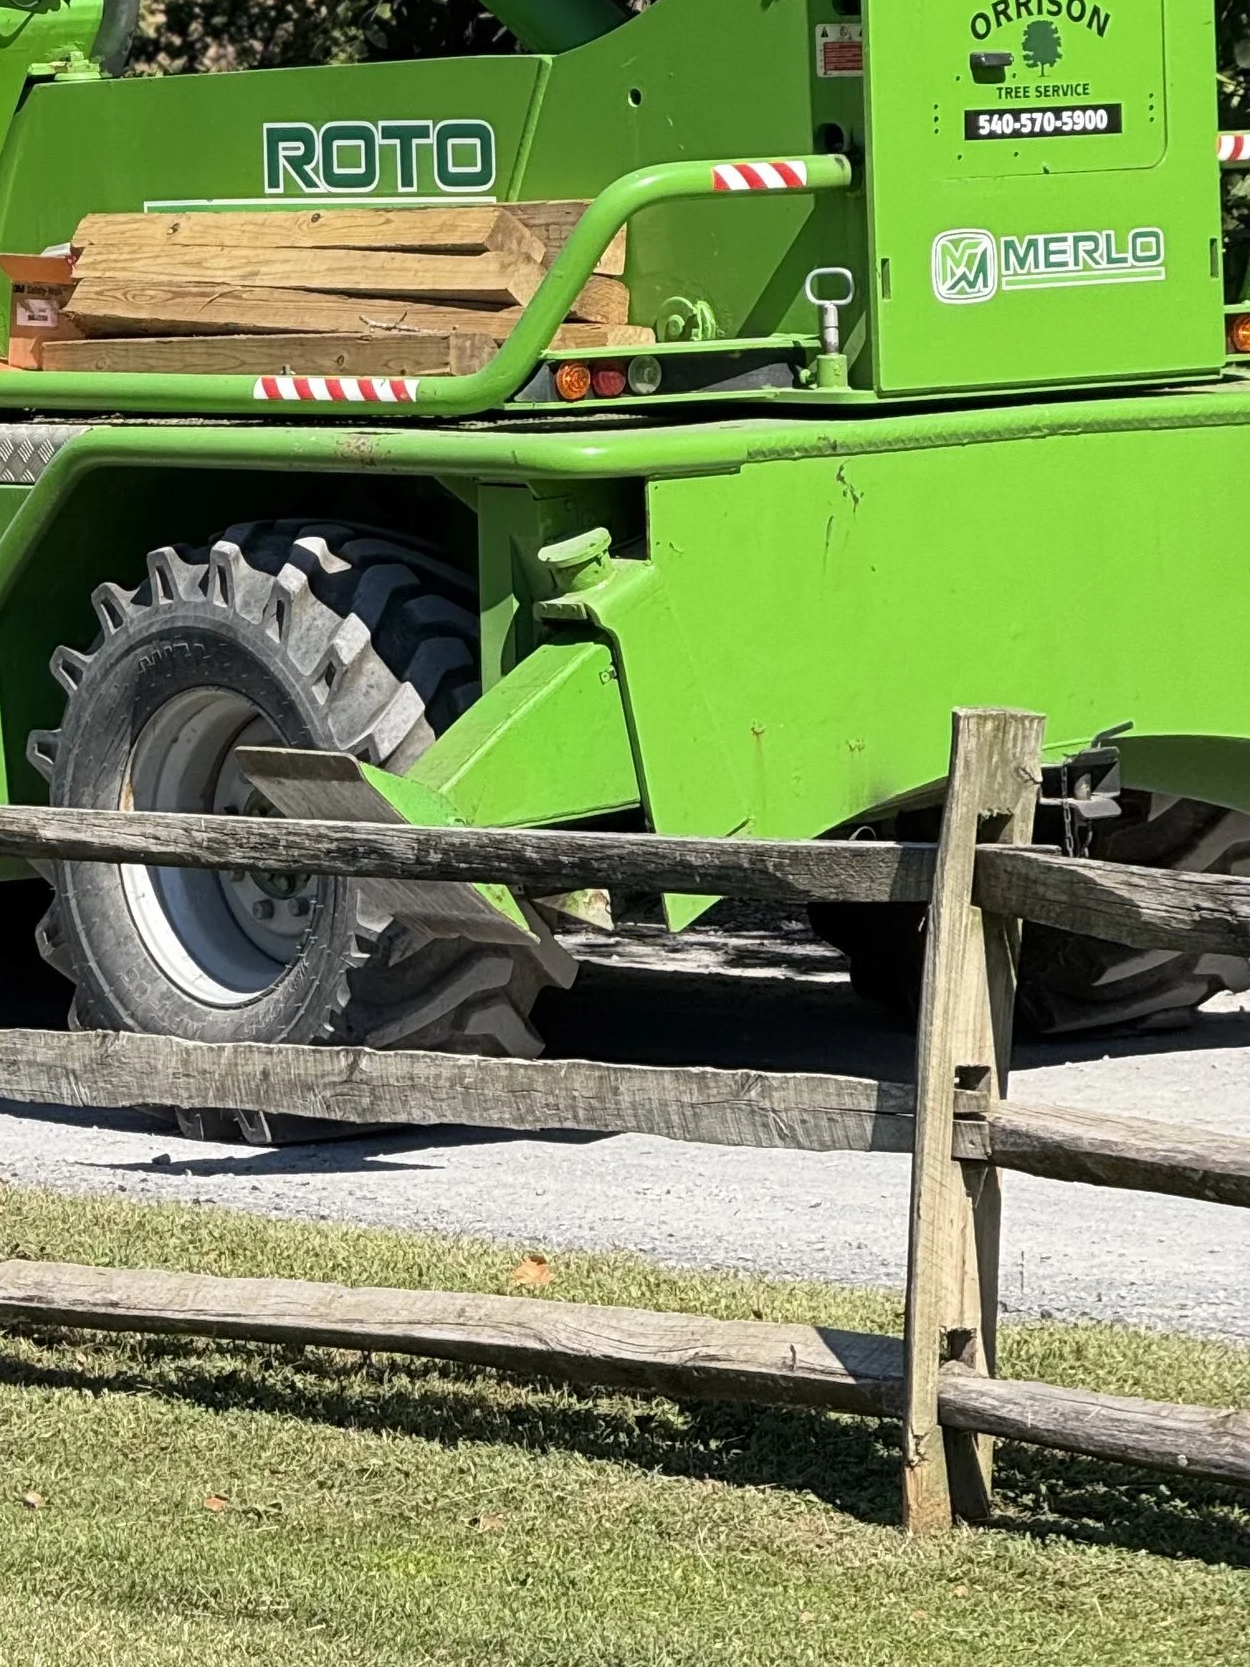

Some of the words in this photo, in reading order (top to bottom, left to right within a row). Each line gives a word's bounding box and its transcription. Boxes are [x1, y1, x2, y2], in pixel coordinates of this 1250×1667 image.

[996, 85, 1031, 100] TREE
[1035, 83, 1090, 98] SERVICE
[978, 109, 1108, 135] 540-570-5900
[263, 119, 496, 194] ROTO
[1001, 228, 1164, 272] MERLO
